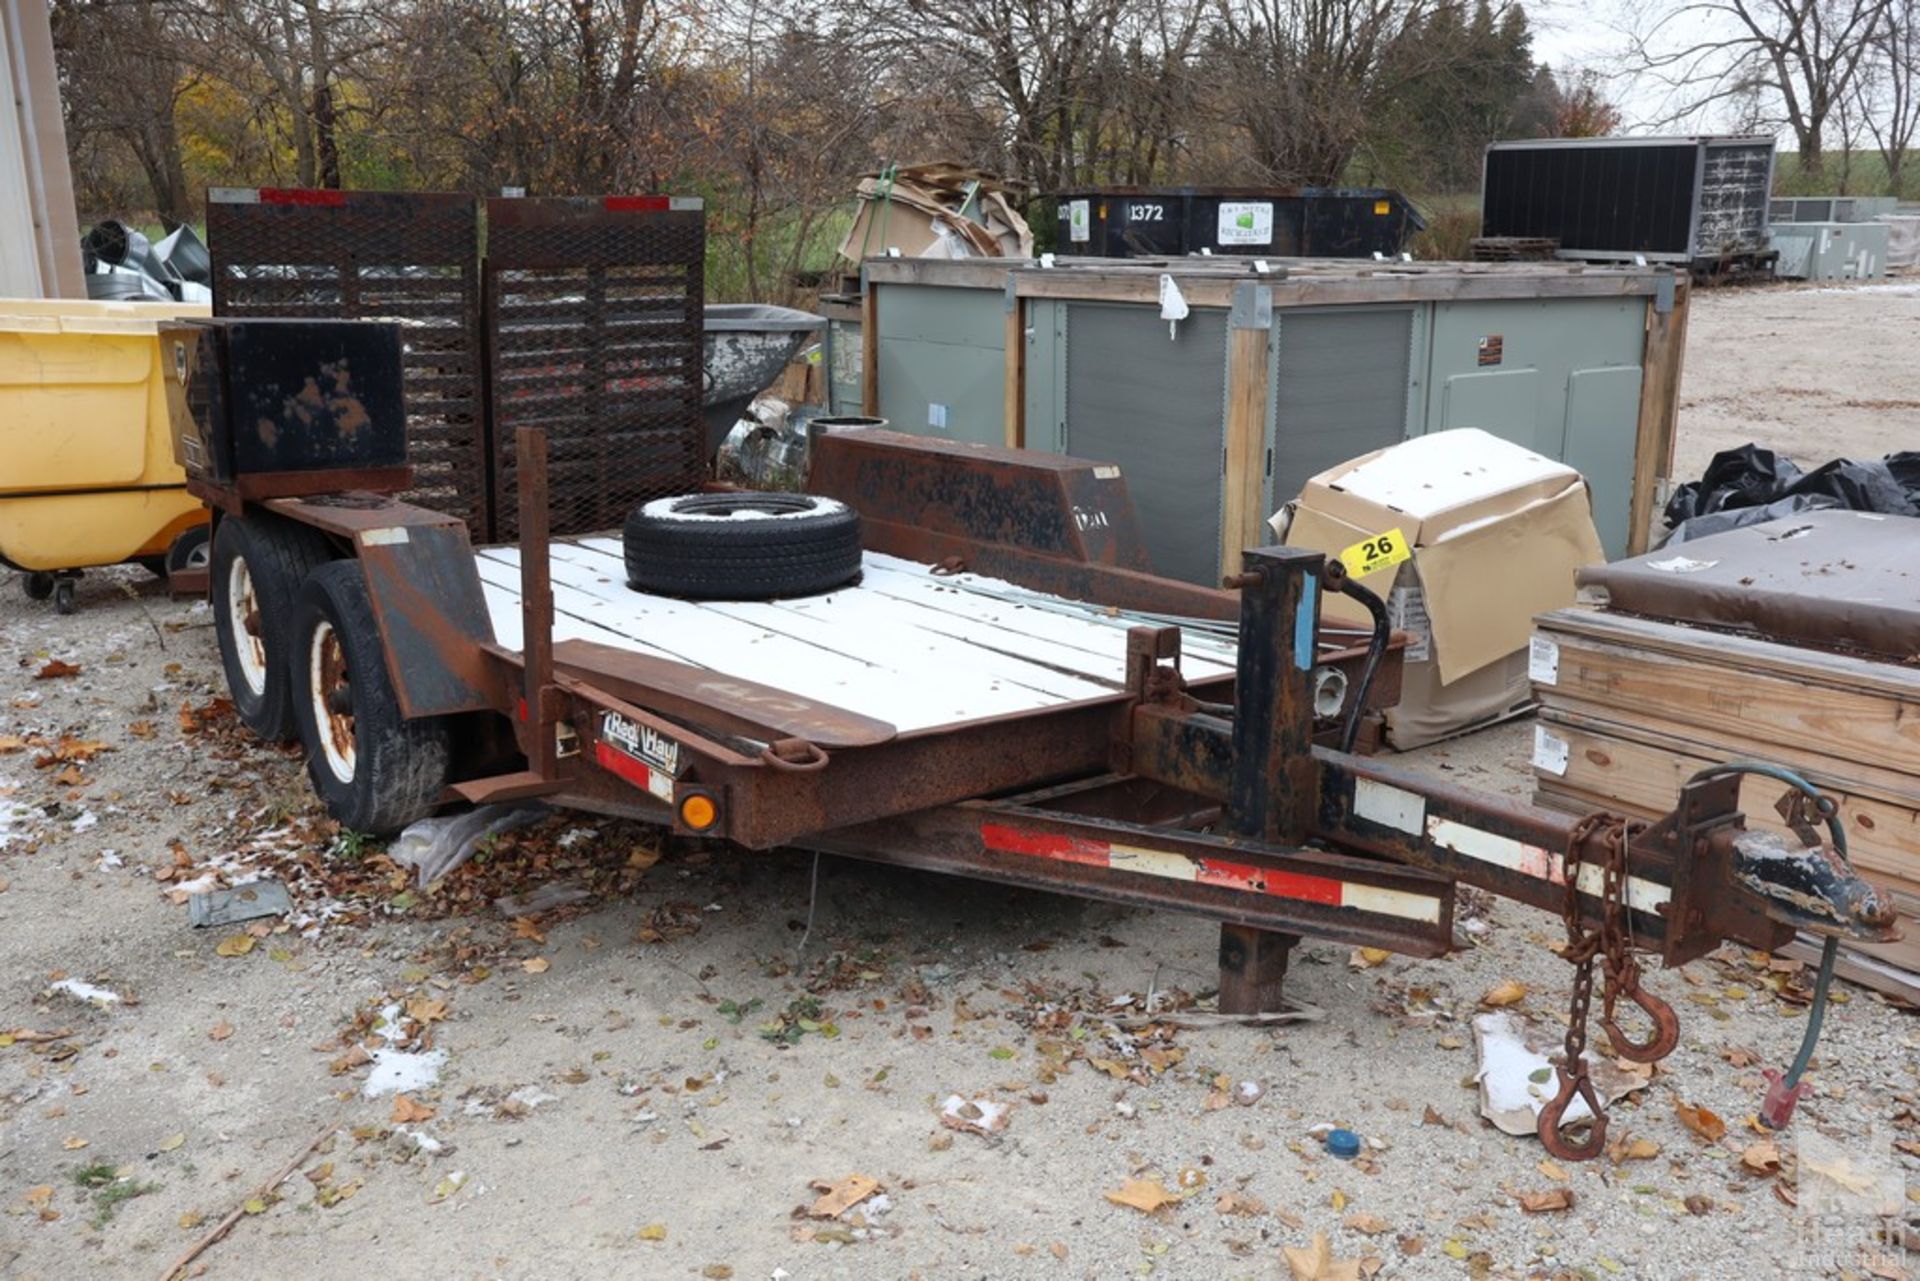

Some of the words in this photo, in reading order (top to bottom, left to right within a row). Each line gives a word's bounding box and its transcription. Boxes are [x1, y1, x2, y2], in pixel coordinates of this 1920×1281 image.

[1130, 205, 1164, 221] 1372
[1362, 536, 1393, 561] 26
[644, 726, 678, 760] Haul
